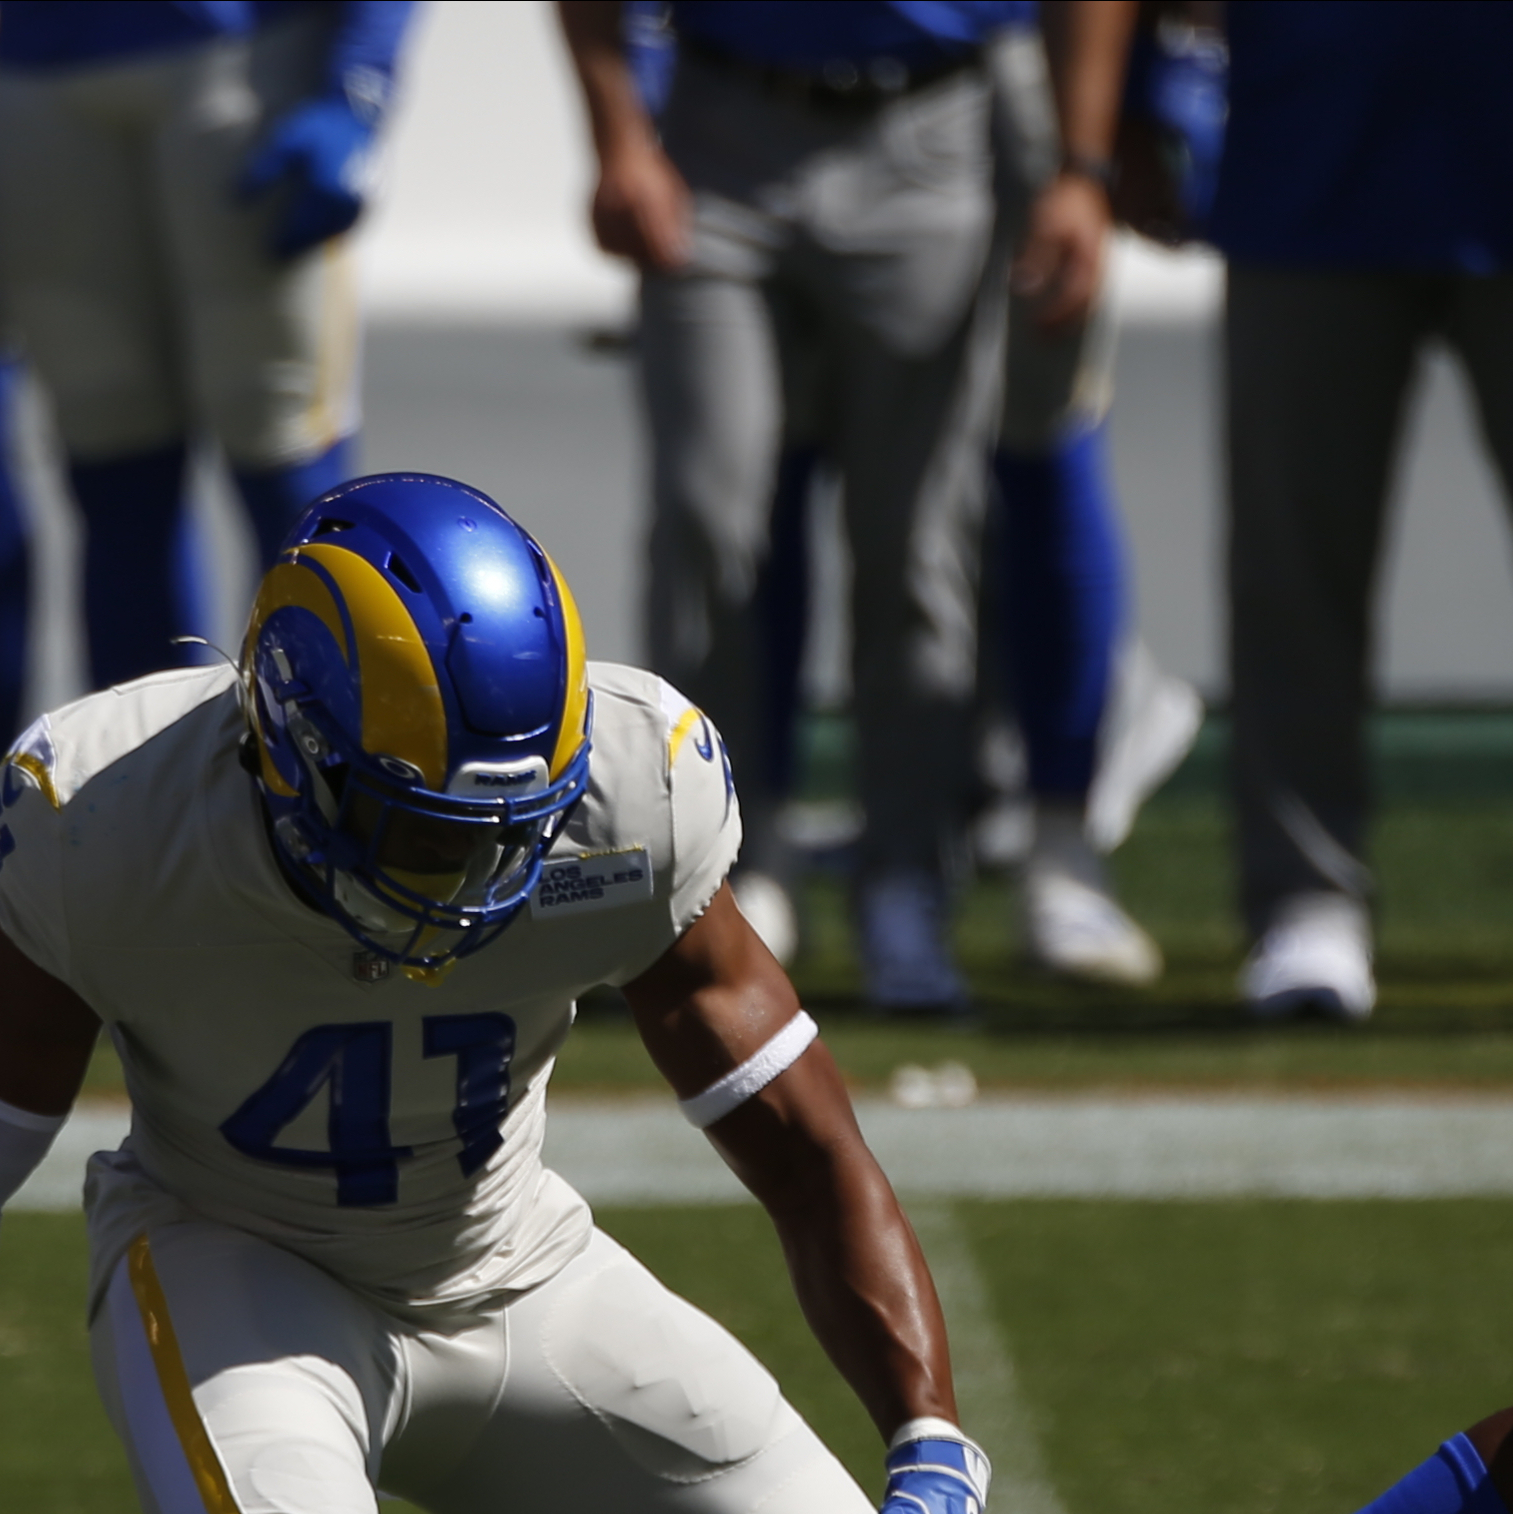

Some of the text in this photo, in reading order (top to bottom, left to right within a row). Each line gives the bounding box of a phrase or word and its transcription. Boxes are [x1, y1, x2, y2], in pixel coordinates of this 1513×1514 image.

[539, 868, 643, 894] ANGELES
[540, 887, 605, 908] RAMS
[218, 1011, 517, 1207] 41
